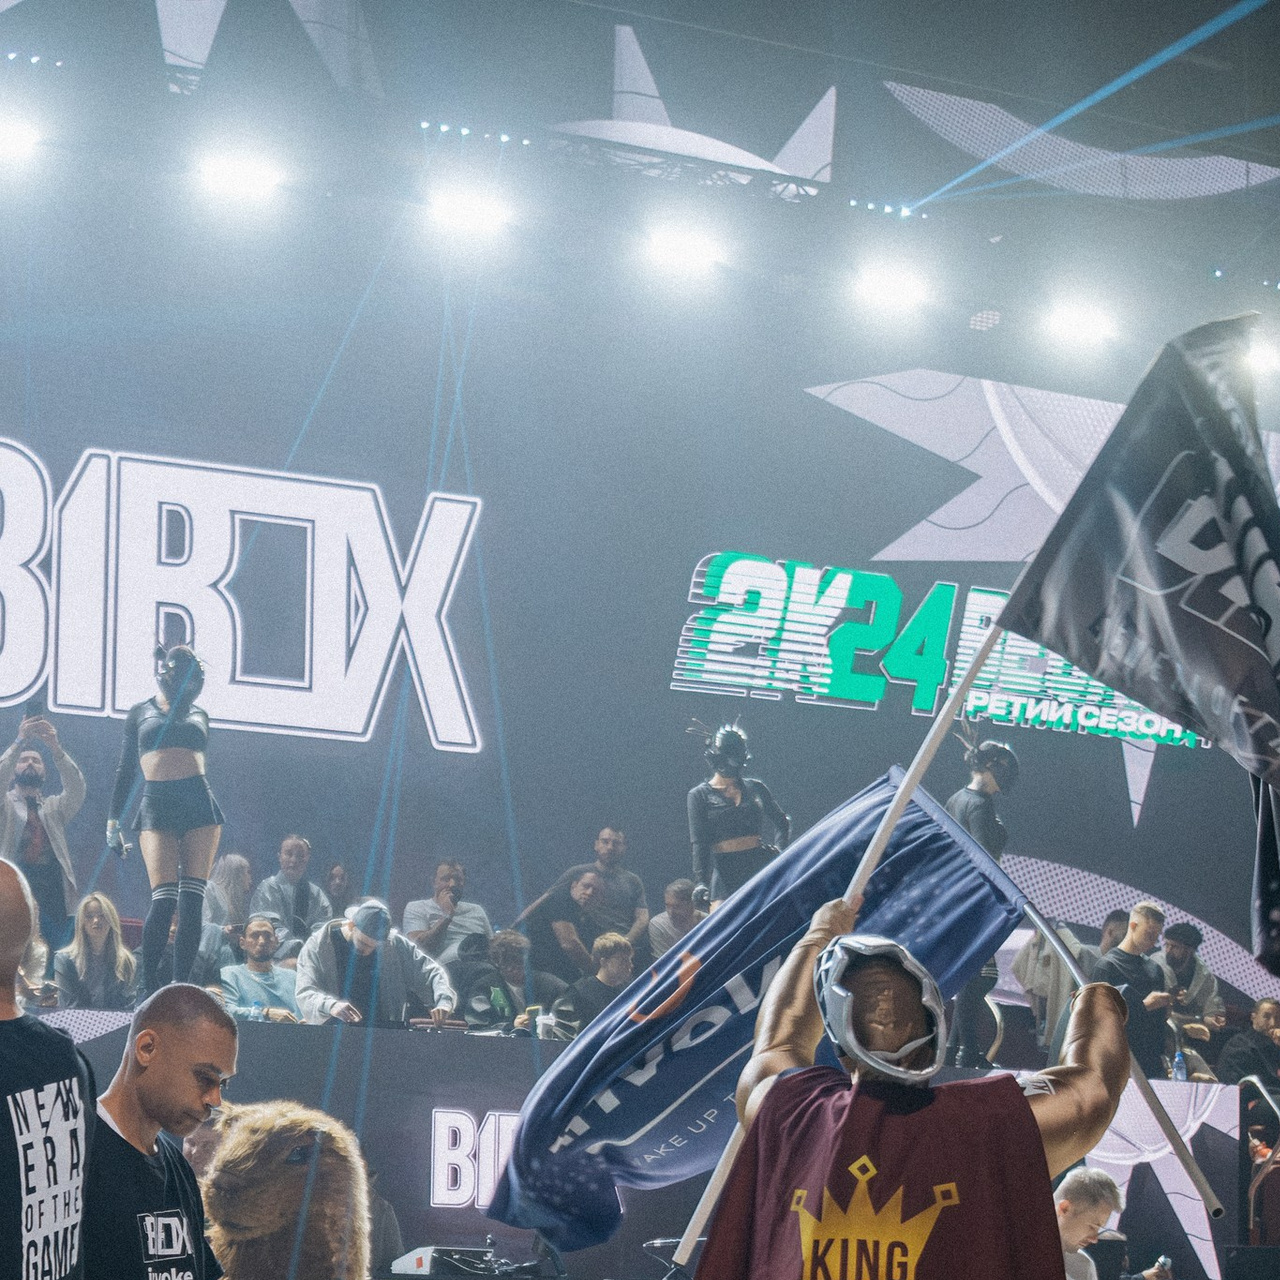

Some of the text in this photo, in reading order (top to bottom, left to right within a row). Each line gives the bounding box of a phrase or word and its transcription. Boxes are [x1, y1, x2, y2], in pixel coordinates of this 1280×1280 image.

[964, 690, 1074, 728] РЕТИЙ
[642, 1134, 688, 1164] AKE
[687, 1107, 718, 1134] UP
[22, 1128, 81, 1197] ERA
[24, 1185, 80, 1233] OF THE
